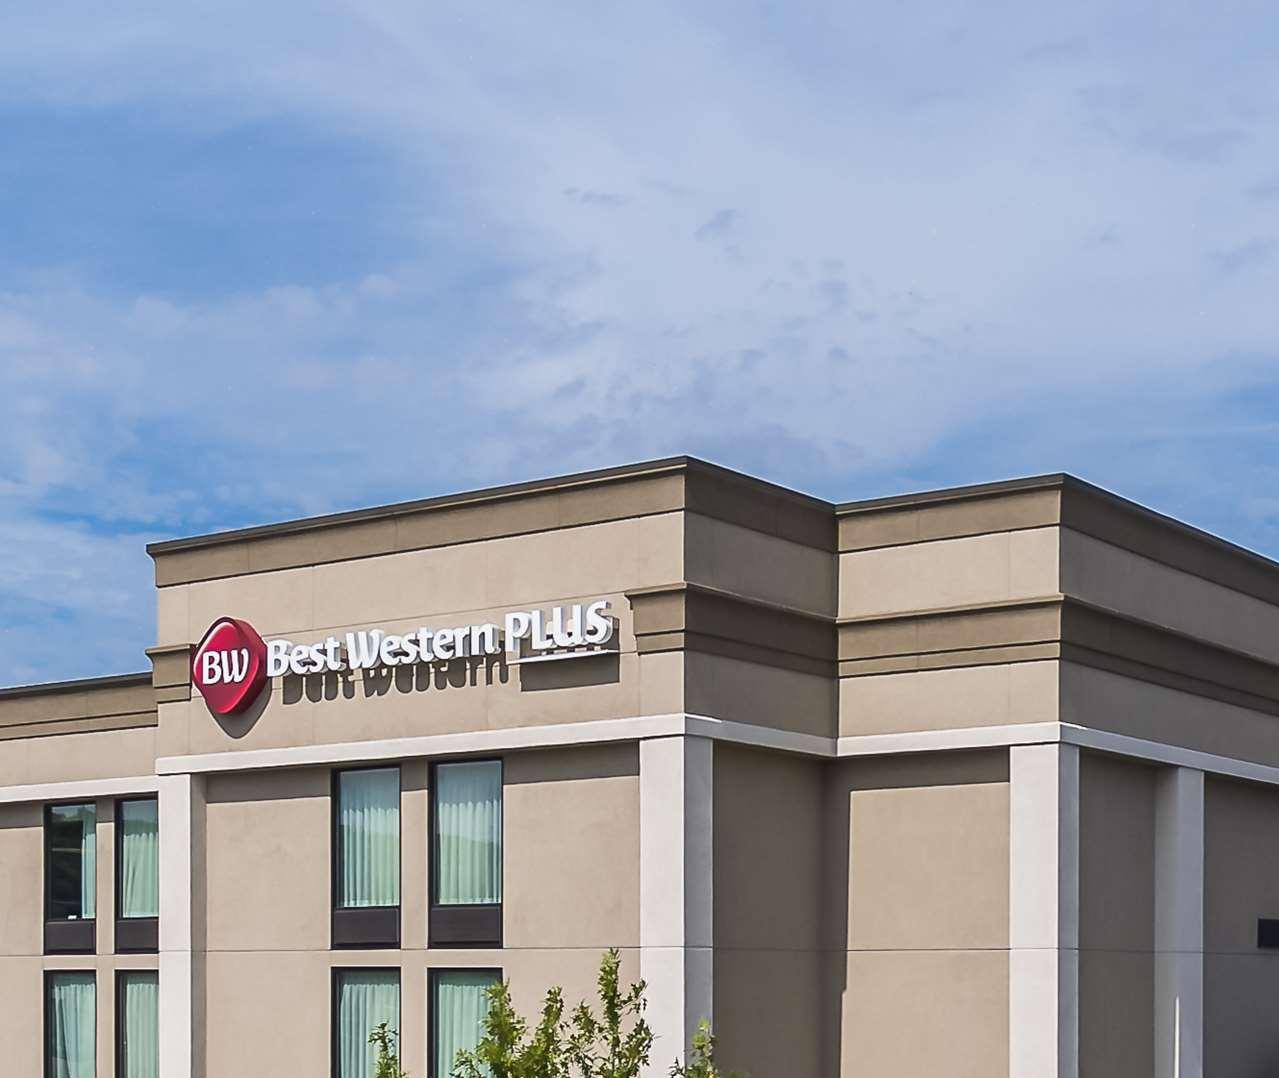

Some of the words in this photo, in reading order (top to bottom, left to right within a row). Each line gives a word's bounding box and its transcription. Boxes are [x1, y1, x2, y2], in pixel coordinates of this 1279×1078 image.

[202, 647, 249, 685] BW
[266, 636, 341, 678] Best
[345, 622, 499, 671] Western
[504, 599, 610, 652] PLUS
